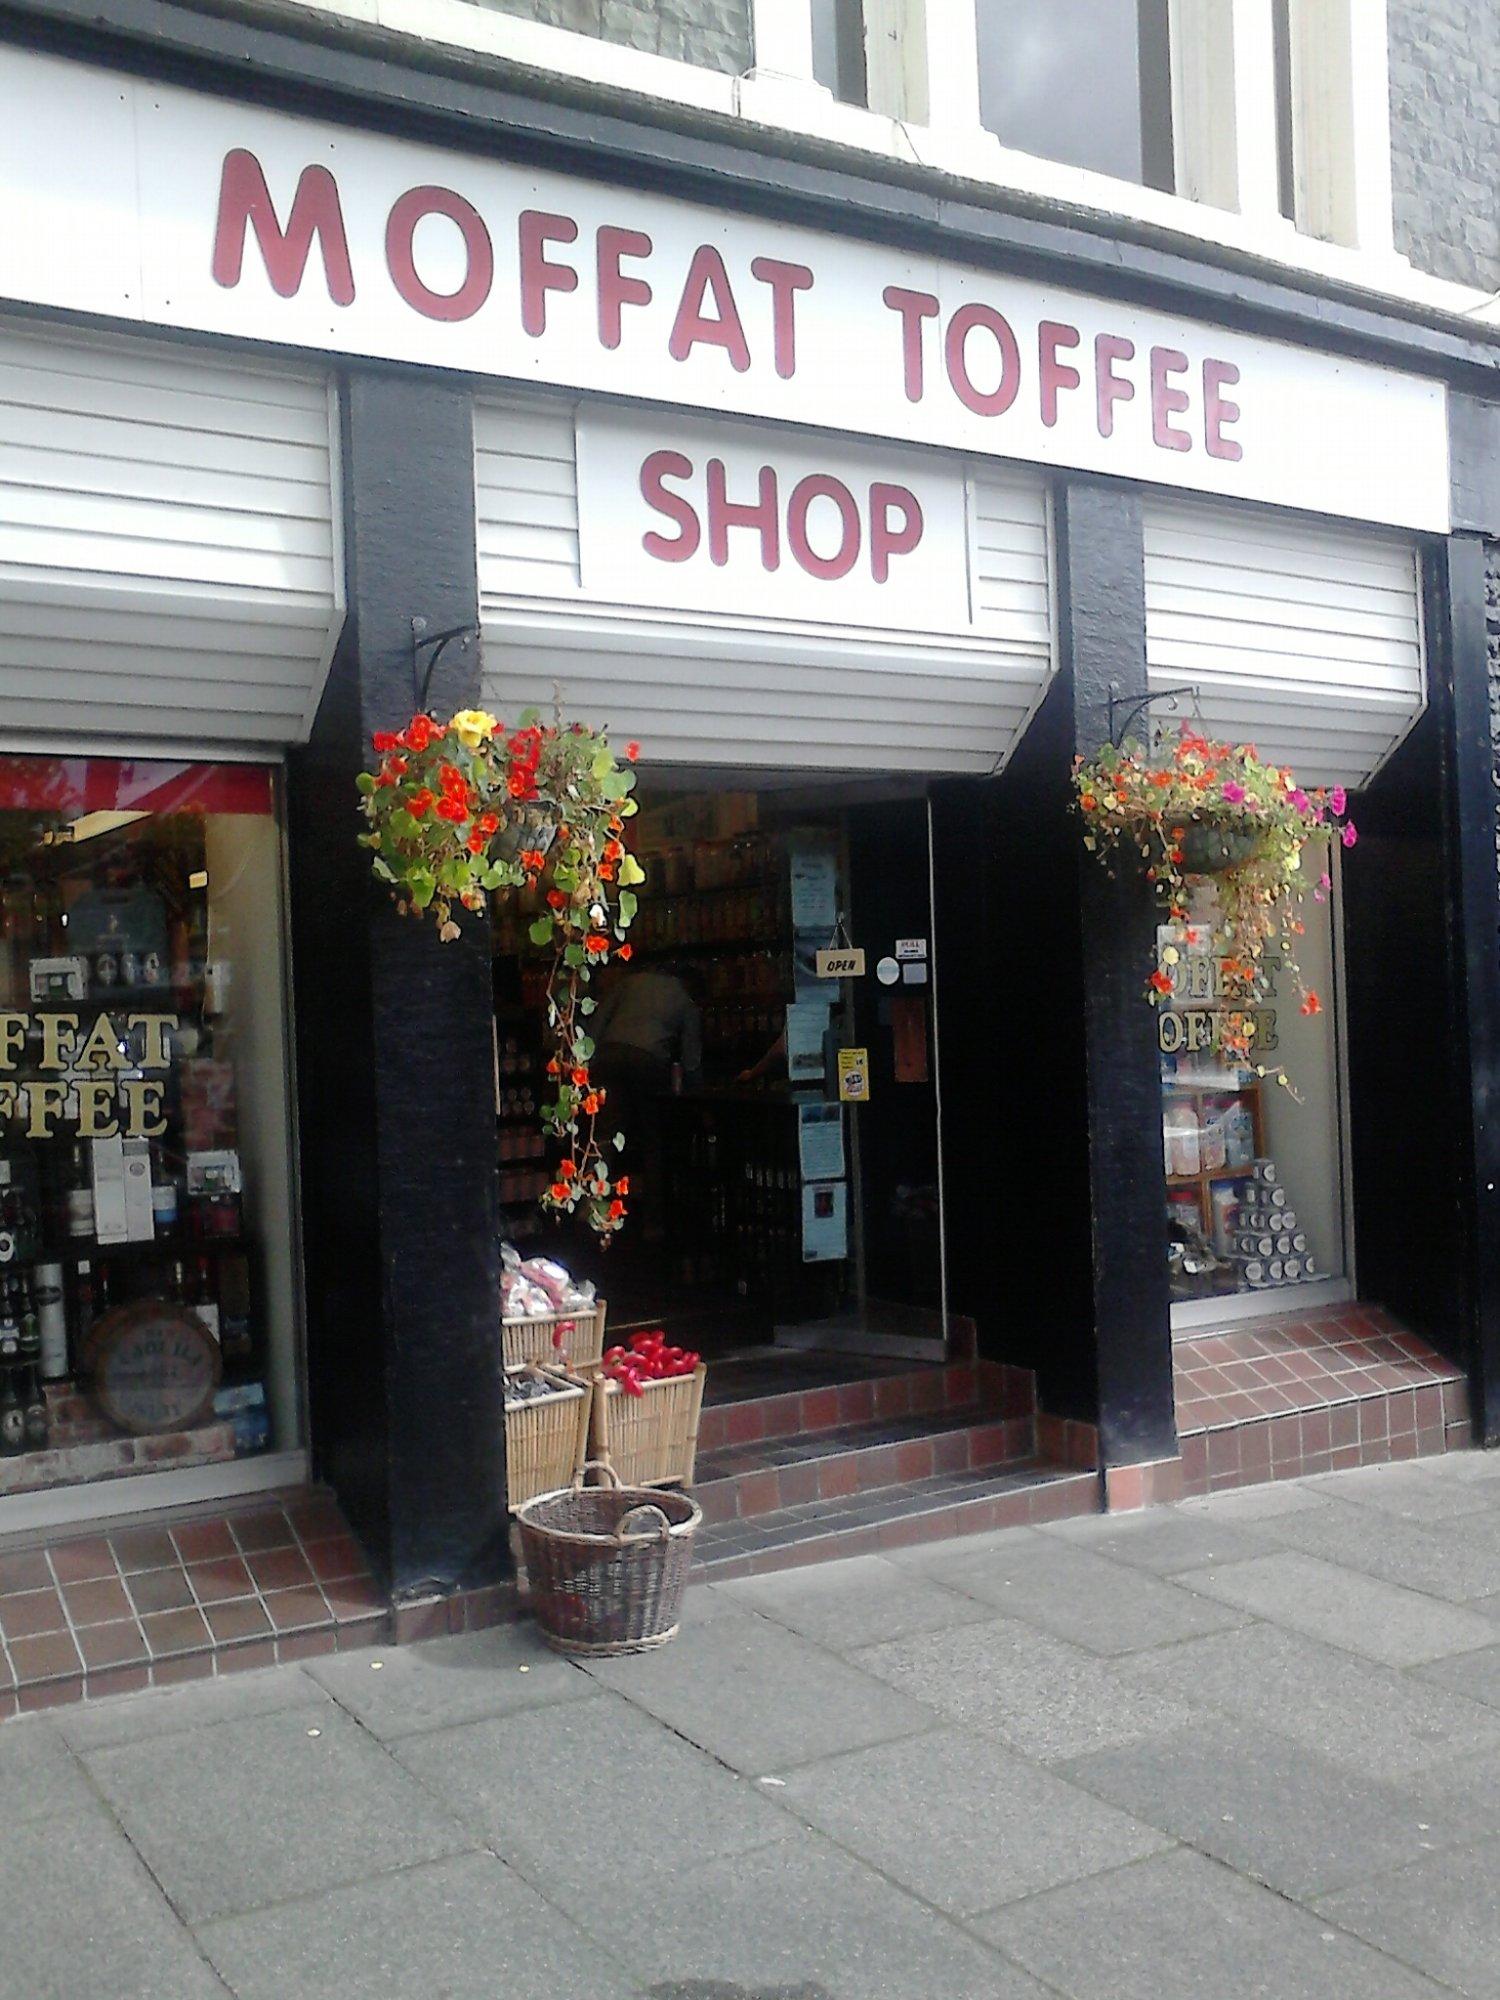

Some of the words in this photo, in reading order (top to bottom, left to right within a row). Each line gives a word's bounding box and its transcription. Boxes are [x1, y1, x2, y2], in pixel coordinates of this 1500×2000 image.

[212, 148, 815, 380] MOFFAT
[882, 286, 1244, 462] TOFFEE
[640, 449, 924, 585] SHOP
[826, 960, 857, 972] OPEN
